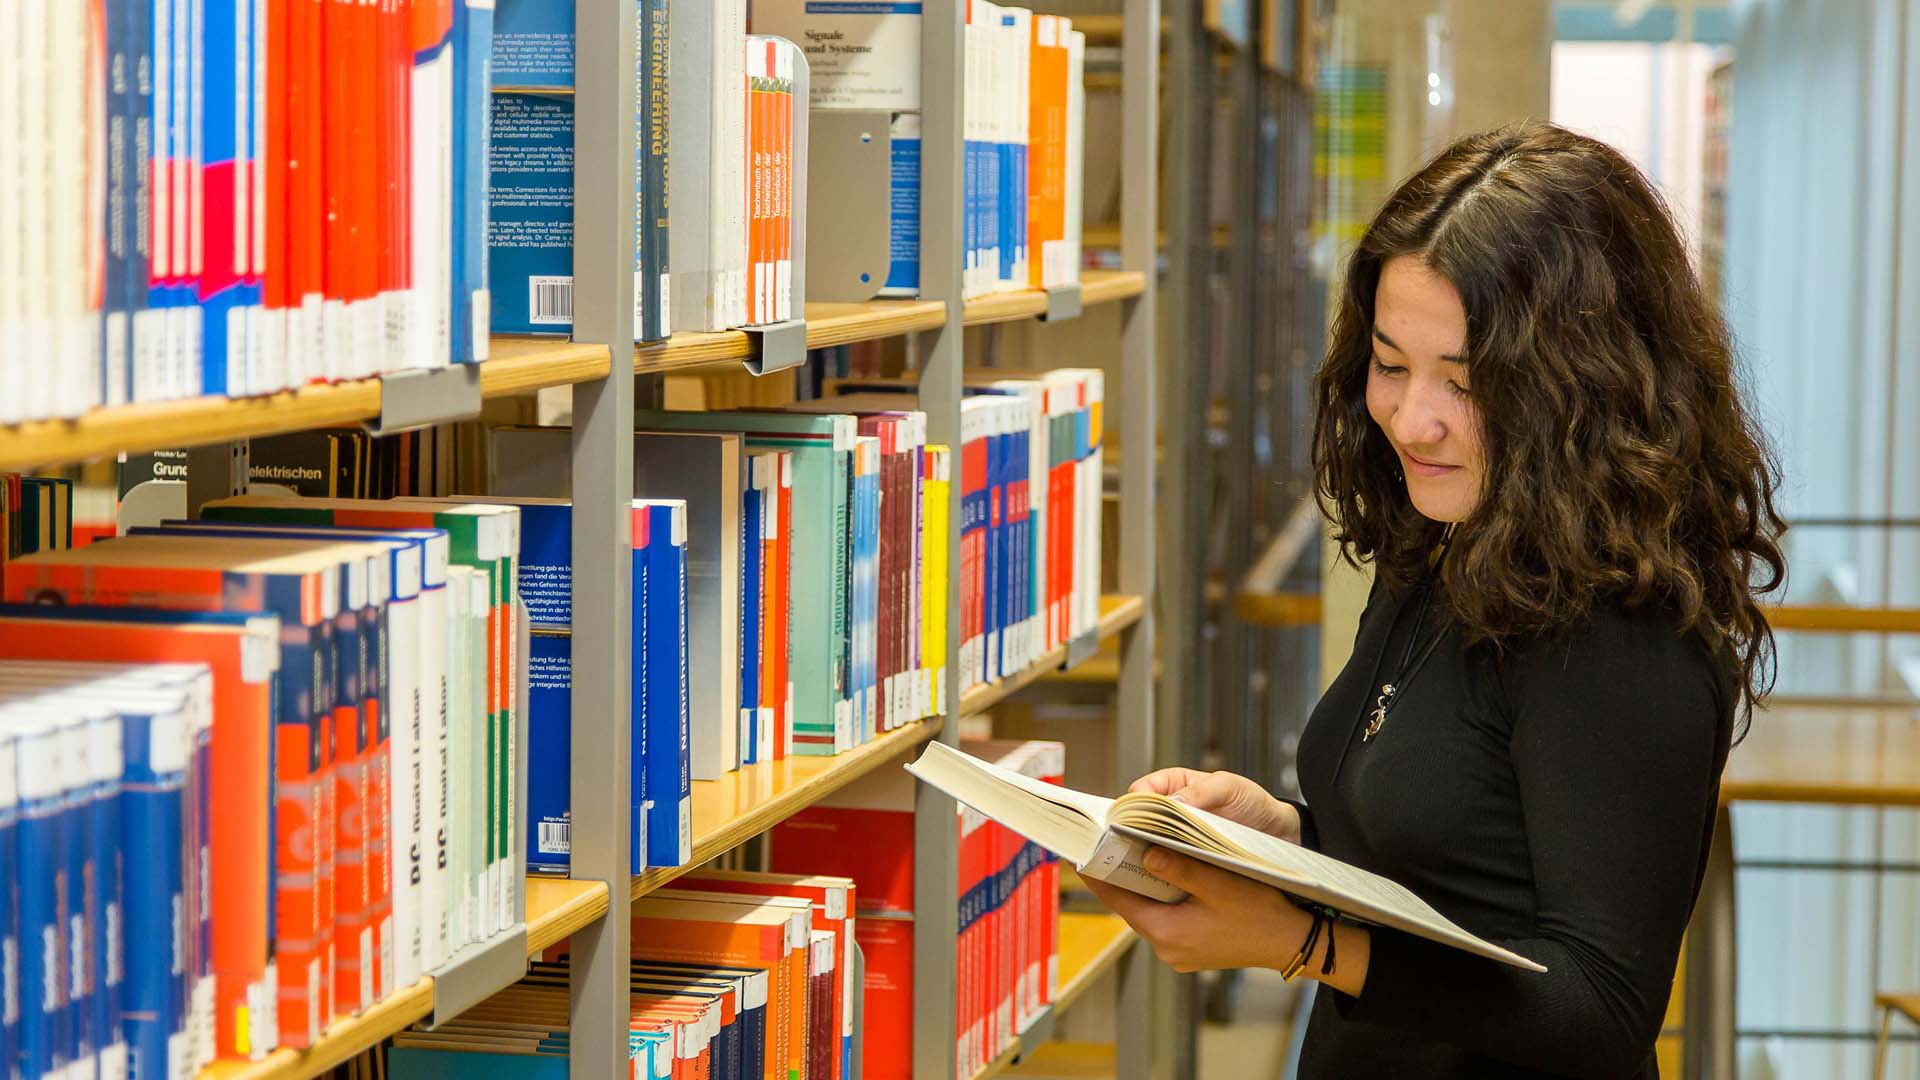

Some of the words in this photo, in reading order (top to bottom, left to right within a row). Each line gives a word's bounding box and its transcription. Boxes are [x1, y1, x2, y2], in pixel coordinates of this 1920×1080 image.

[804, 29, 845, 43] Signale
[828, 45, 873, 57] Systeme
[651, 9, 663, 156] ENGINEERING
[249, 465, 323, 480] elektrischen
[834, 503, 845, 636] TELECOMMUNICATIONS
[679, 560, 688, 752] Nachrichtentechnik
